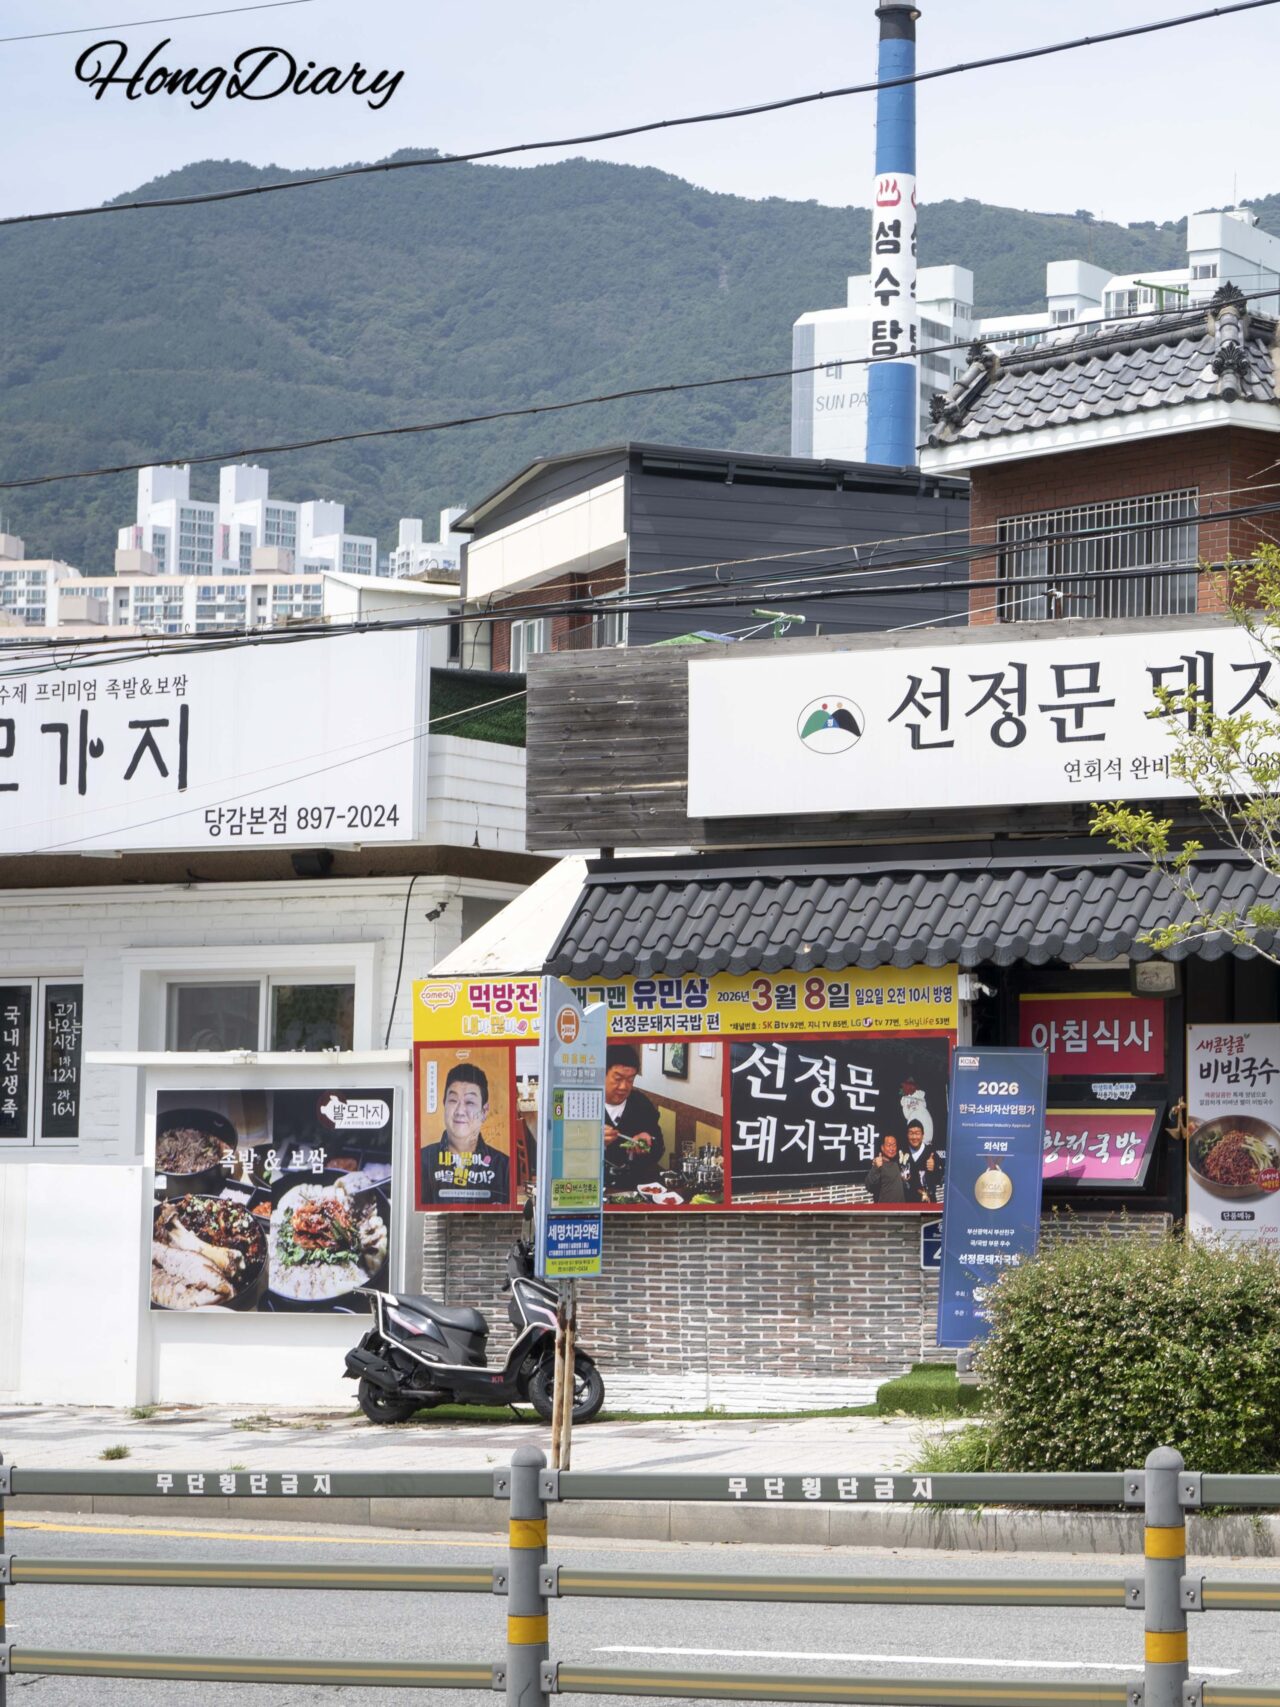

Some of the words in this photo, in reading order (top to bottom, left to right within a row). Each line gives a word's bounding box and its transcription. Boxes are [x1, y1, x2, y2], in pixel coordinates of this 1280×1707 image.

[870, 218, 904, 356] 섬수탕
[815, 394, 846, 412] SUN
[848, 392, 869, 410] PA
[34, 678, 98, 703] 프리미엄
[104, 674, 189, 699] 족발&보쌈
[887, 661, 1116, 750] 선정문
[1063, 757, 1123, 783] 연회석
[1130, 755, 1171, 781] 완비
[204, 805, 288, 837] 당감본점
[296, 804, 400, 830] 897-2024
[420, 990, 454, 1001] comedy
[469, 982, 541, 1013] 먹방전
[633, 979, 709, 1010] 유민상
[717, 991, 750, 1003] 2026년
[752, 978, 797, 1011] 3월
[804, 977, 850, 1010] 8일
[855, 987, 884, 1005] 일요일
[886, 987, 906, 1005] 오전
[908, 986, 930, 1004] 10시
[933, 986, 952, 1003] 방영
[54, 1002, 77, 1017] 고기
[48, 1018, 83, 1034] 나오는
[611, 1014, 703, 1033] 선정문돼지국밥
[707, 1013, 720, 1032] 편
[53, 1034, 77, 1050] 시간
[1030, 1019, 1153, 1053] 아침식사
[1196, 1034, 1246, 1056] 새콤달콤
[1, 1005, 21, 1119] 국내산생족
[1199, 1056, 1280, 1088] 비빔국수
[52, 1067, 76, 1083] 12시
[731, 1042, 880, 1113] 선정문
[977, 1081, 1019, 1096] 2026
[51, 1100, 76, 1117] 16시
[332, 1103, 384, 1121] 발모가지
[959, 1103, 1036, 1116] 한국소비자산업평가
[731, 1115, 880, 1164] 돼지국밥
[983, 1141, 1008, 1152] 외식업
[219, 1148, 258, 1175] 족발
[264, 1149, 282, 1172] &
[289, 1147, 328, 1174] 보쌈
[547, 1223, 599, 1241] 세명치과의원
[156, 1473, 332, 1495] 무단횡단금지
[727, 1477, 934, 1500] 무단횡단금지
